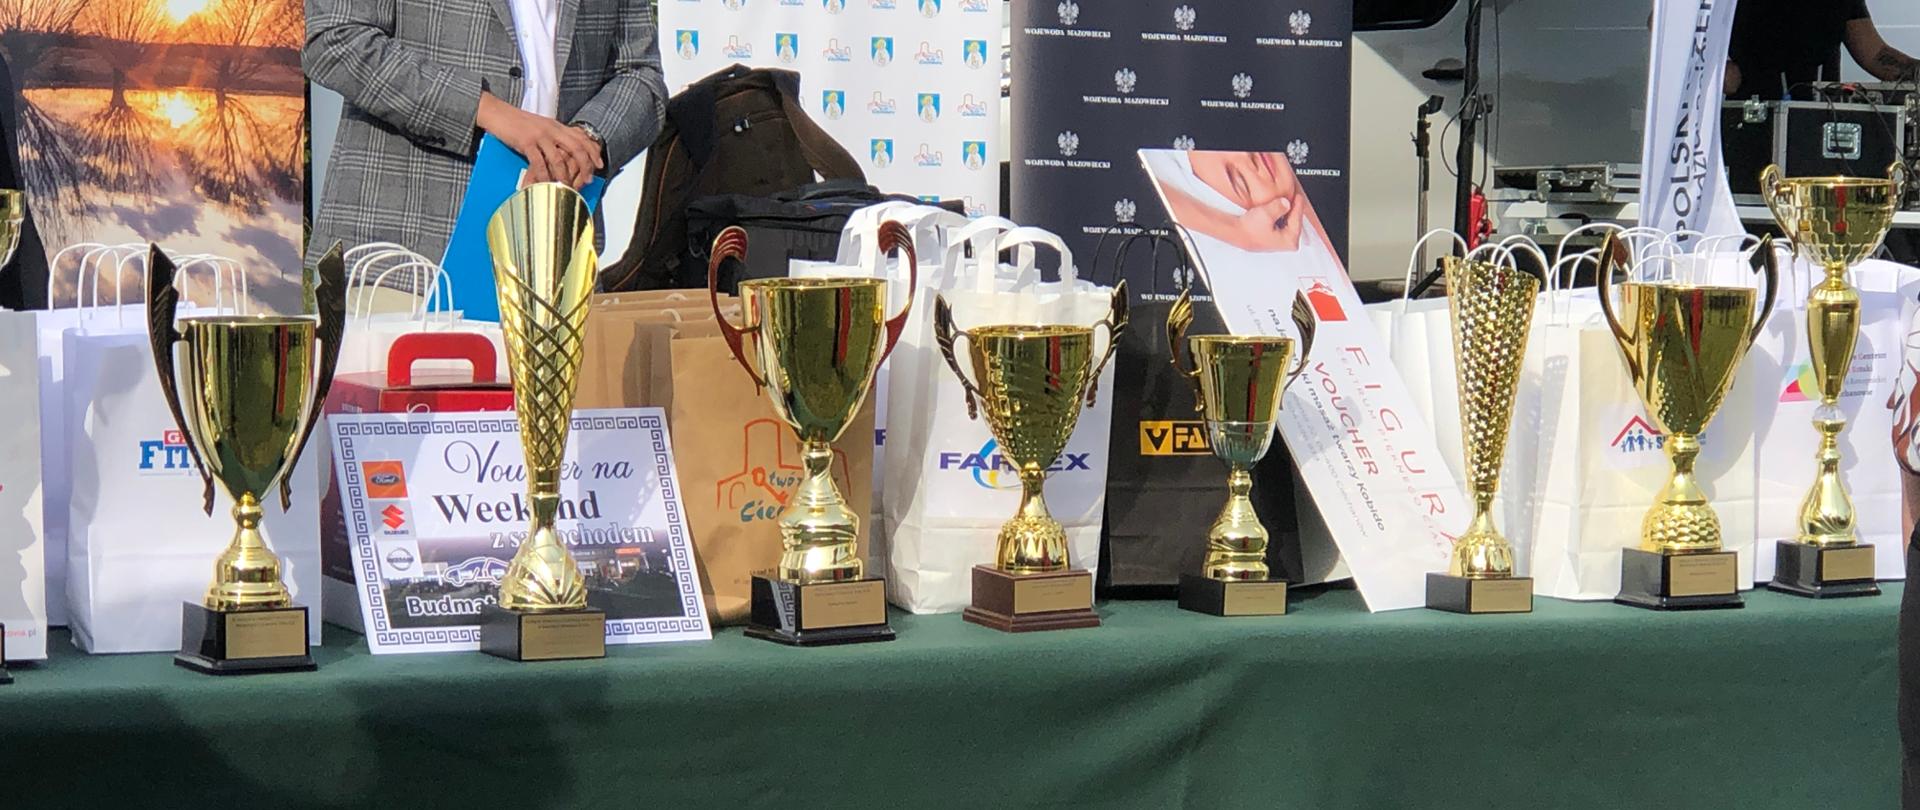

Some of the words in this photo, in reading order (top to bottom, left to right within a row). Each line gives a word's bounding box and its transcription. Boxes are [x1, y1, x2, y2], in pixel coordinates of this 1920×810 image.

[1024, 27, 1065, 36] WOJEWODA
[1066, 29, 1111, 38] MAZOWIECKI
[1142, 32, 1181, 41] WOJEWODA
[1183, 34, 1227, 43] MAZOWIECKI
[1256, 37, 1296, 46] WOJEWODA
[1298, 39, 1343, 48] MAZOWIECKI
[1083, 95, 1122, 104] WOJEWODA
[1124, 97, 1169, 106] MAZOWIECKI
[1200, 99, 1239, 108] WOJEWODA
[1240, 101, 1284, 110] MAZOWIECKI
[1024, 158, 1065, 168] WOJEWODA
[1066, 160, 1111, 169] MAZOWIECKI
[1296, 168, 1341, 177] MAZOWIECKI
[1671, 100, 1691, 242] POLSK
[1141, 293, 1180, 302] WOEWODA
[1315, 362, 1379, 475] VOUCHER
[444, 440, 583, 483] Vouer
[591, 460, 634, 480] na
[939, 452, 1090, 471] FAREX
[1332, 434, 1360, 480] twarzy
[1356, 482, 1385, 532] Kobido
[432, 491, 602, 525] Weeknd
[490, 531, 504, 549] z
[510, 522, 655, 549] saochodem
